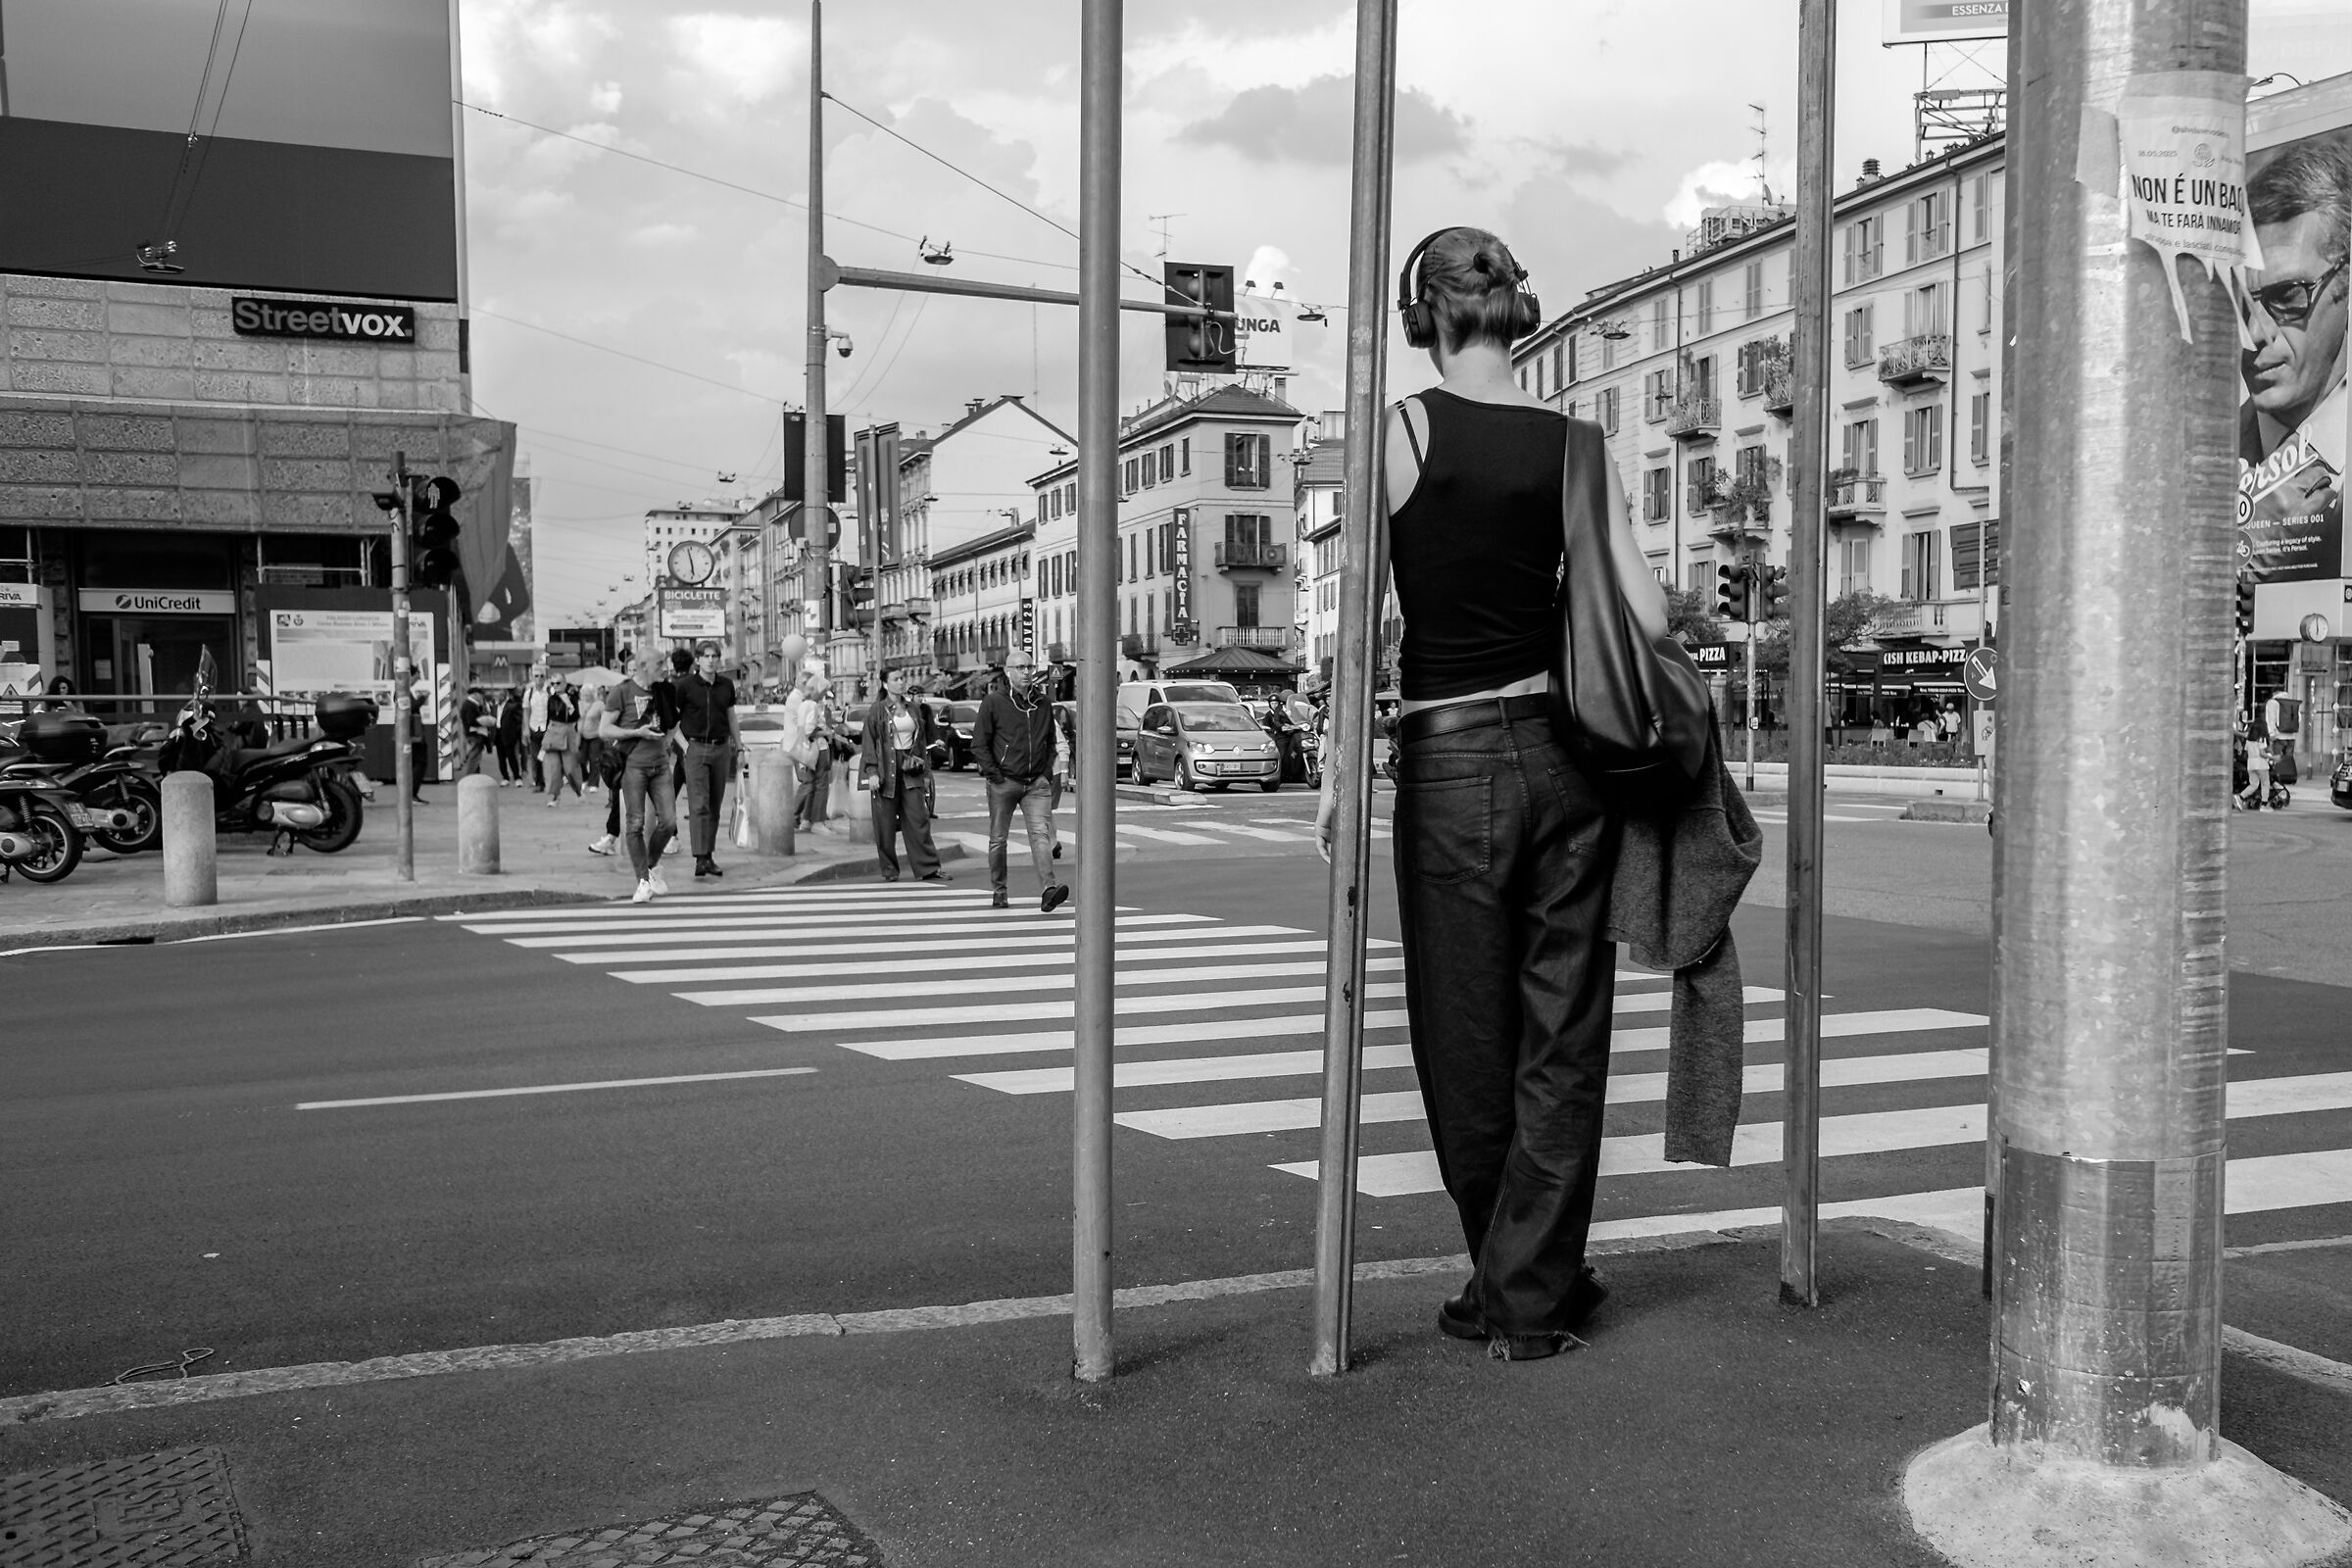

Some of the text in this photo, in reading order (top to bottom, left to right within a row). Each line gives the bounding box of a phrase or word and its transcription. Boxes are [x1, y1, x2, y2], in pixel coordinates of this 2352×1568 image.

[1952, 3, 2002, 16] ESSENZA
[2132, 174, 2167, 204] NON
[2174, 172, 2184, 204] É
[2191, 179, 2216, 206] UN
[2161, 213, 2175, 227] TE
[2282, 515, 2309, 526] SERIES
[2310, 514, 2324, 523] 001
[1176, 514, 1189, 618] FARMACIA
[664, 590, 720, 601] BICICLETTE
[134, 596, 201, 610] UniCredit
[1699, 647, 1726, 662] PIZZA
[1905, 649, 1968, 663] KEBAP-PIZZ
